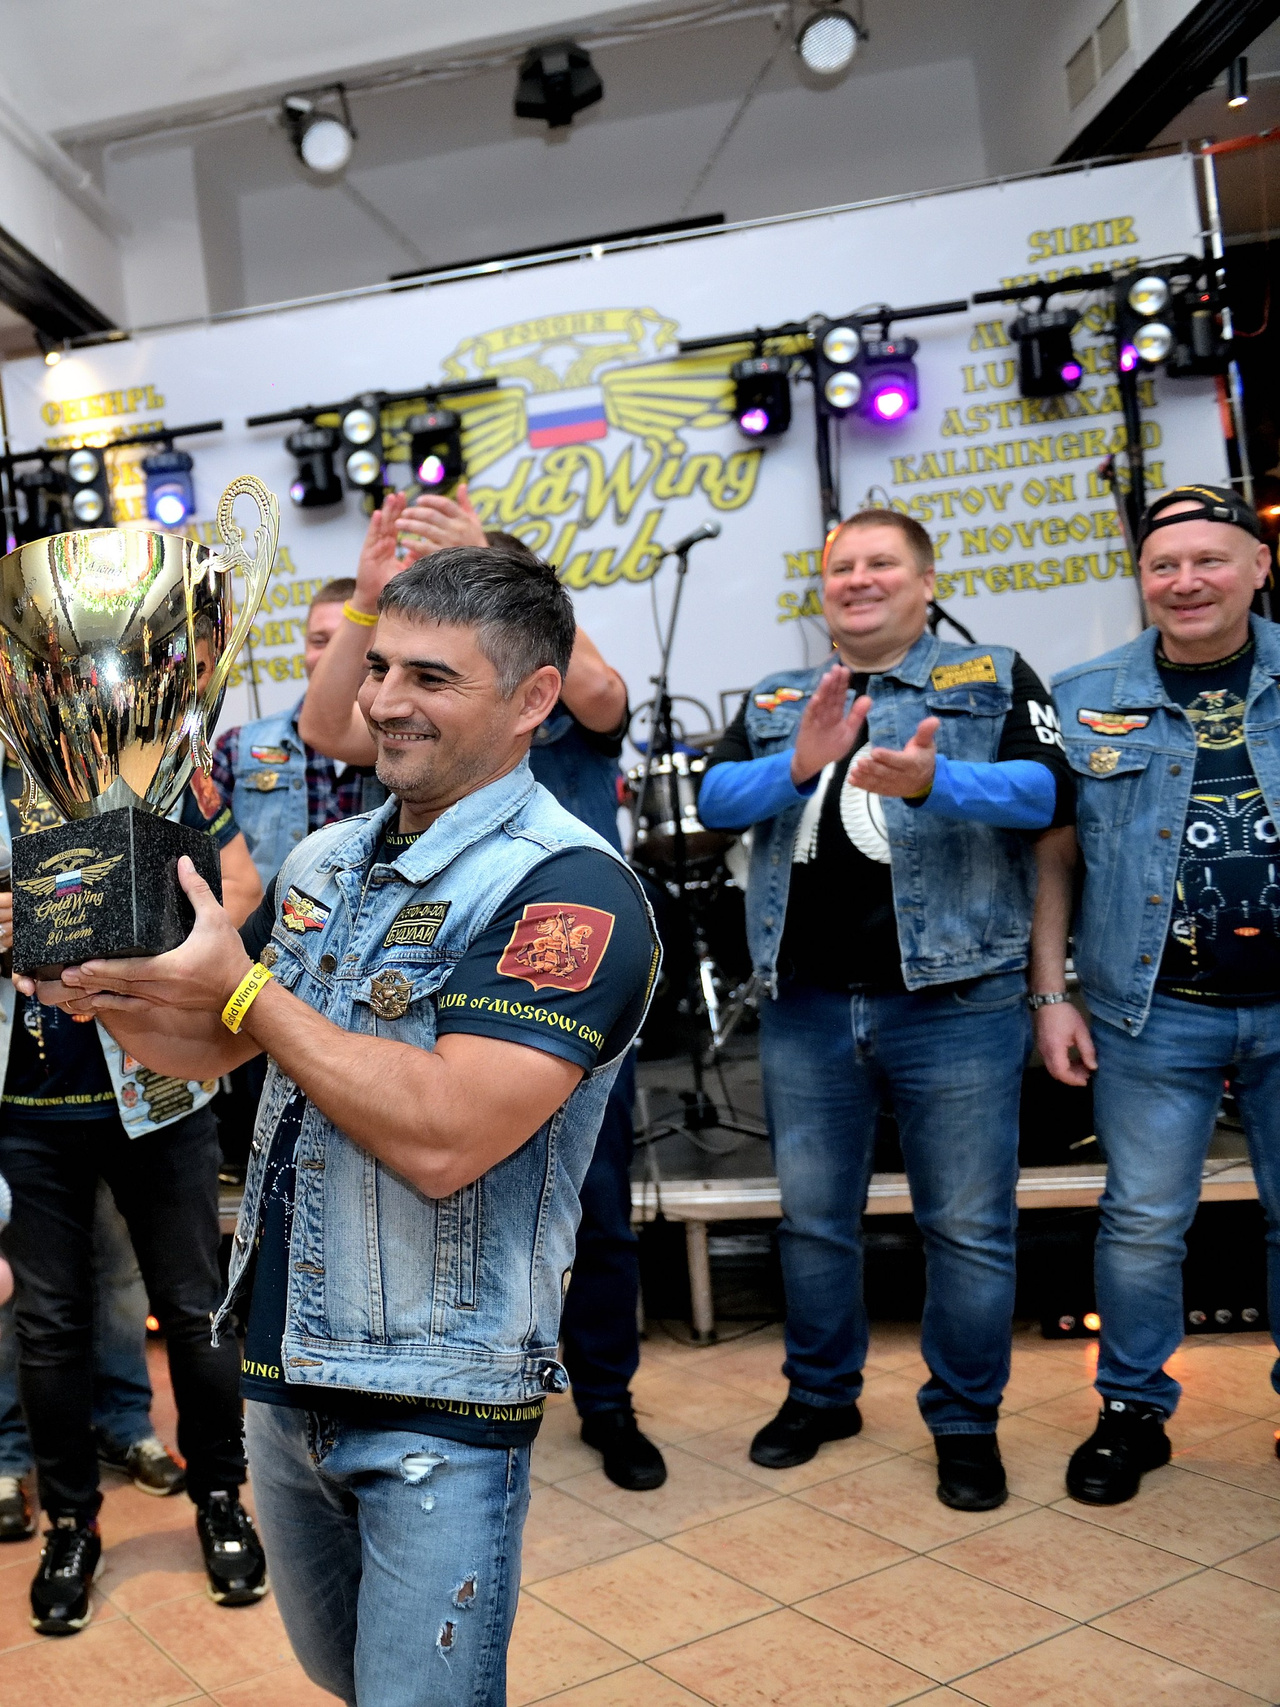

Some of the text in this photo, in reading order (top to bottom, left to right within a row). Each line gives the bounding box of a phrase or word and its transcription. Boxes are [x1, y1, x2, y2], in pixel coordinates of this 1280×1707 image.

[1027, 215, 1139, 264] SIBIR
[860, 482, 1013, 523] OSTOV
[1022, 474, 1076, 508] ON
[960, 509, 1122, 557] NOVGOR
[52, 907, 86, 929] Club
[46, 927, 94, 946] 20 лет
[233, 980, 259, 1008] Wing
[487, 998, 577, 1032] MOSCOW
